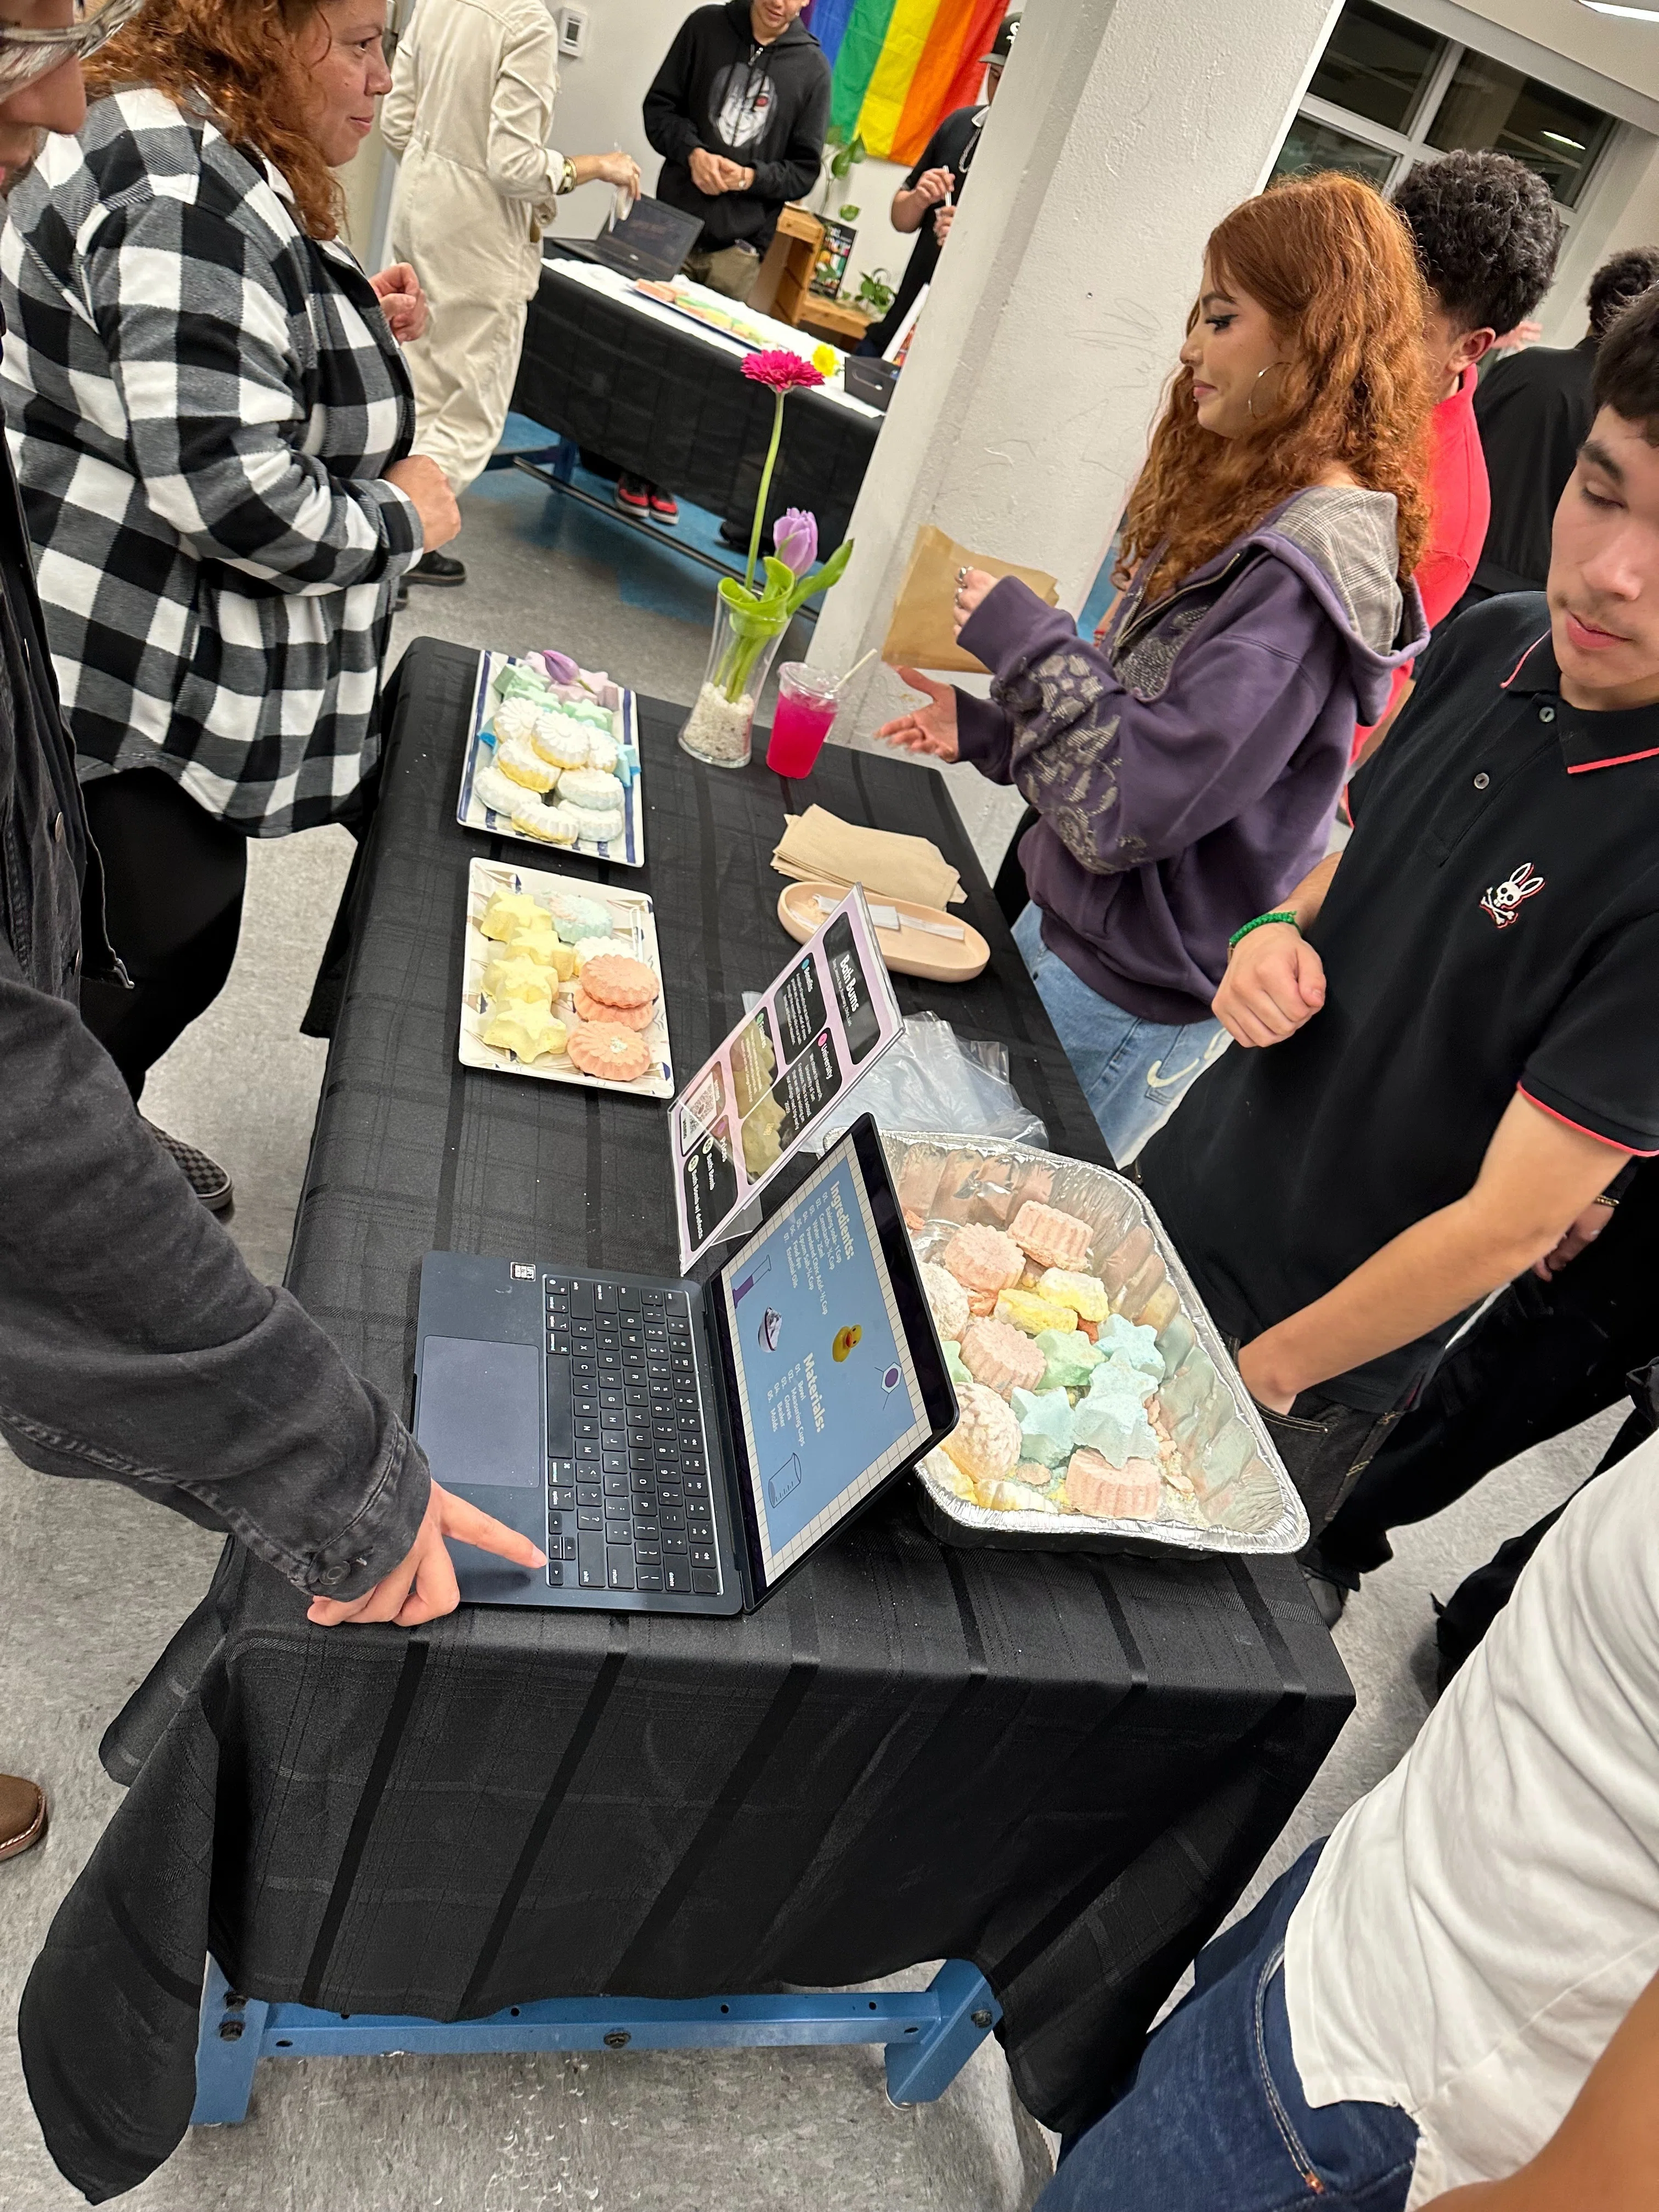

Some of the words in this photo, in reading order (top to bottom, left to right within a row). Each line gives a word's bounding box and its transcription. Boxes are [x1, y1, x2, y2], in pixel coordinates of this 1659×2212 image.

[804, 967, 812, 992] Benefits
[839, 954, 854, 984] Bath
[845, 977, 859, 1012] Bums
[809, 1053, 814, 1062] We
[821, 1043, 832, 1079] University
[796, 1092, 800, 1101] be
[825, 1205, 833, 1229] Baking
[830, 1181, 854, 1260] Ingredients:
[792, 1240, 800, 1257] Food
[805, 1226, 817, 1259] Powdered
[786, 1246, 796, 1276] Essential
[798, 1380, 806, 1401] Bowl
[803, 1352, 825, 1432] Materials:
[791, 1387, 801, 1427] Measuring
